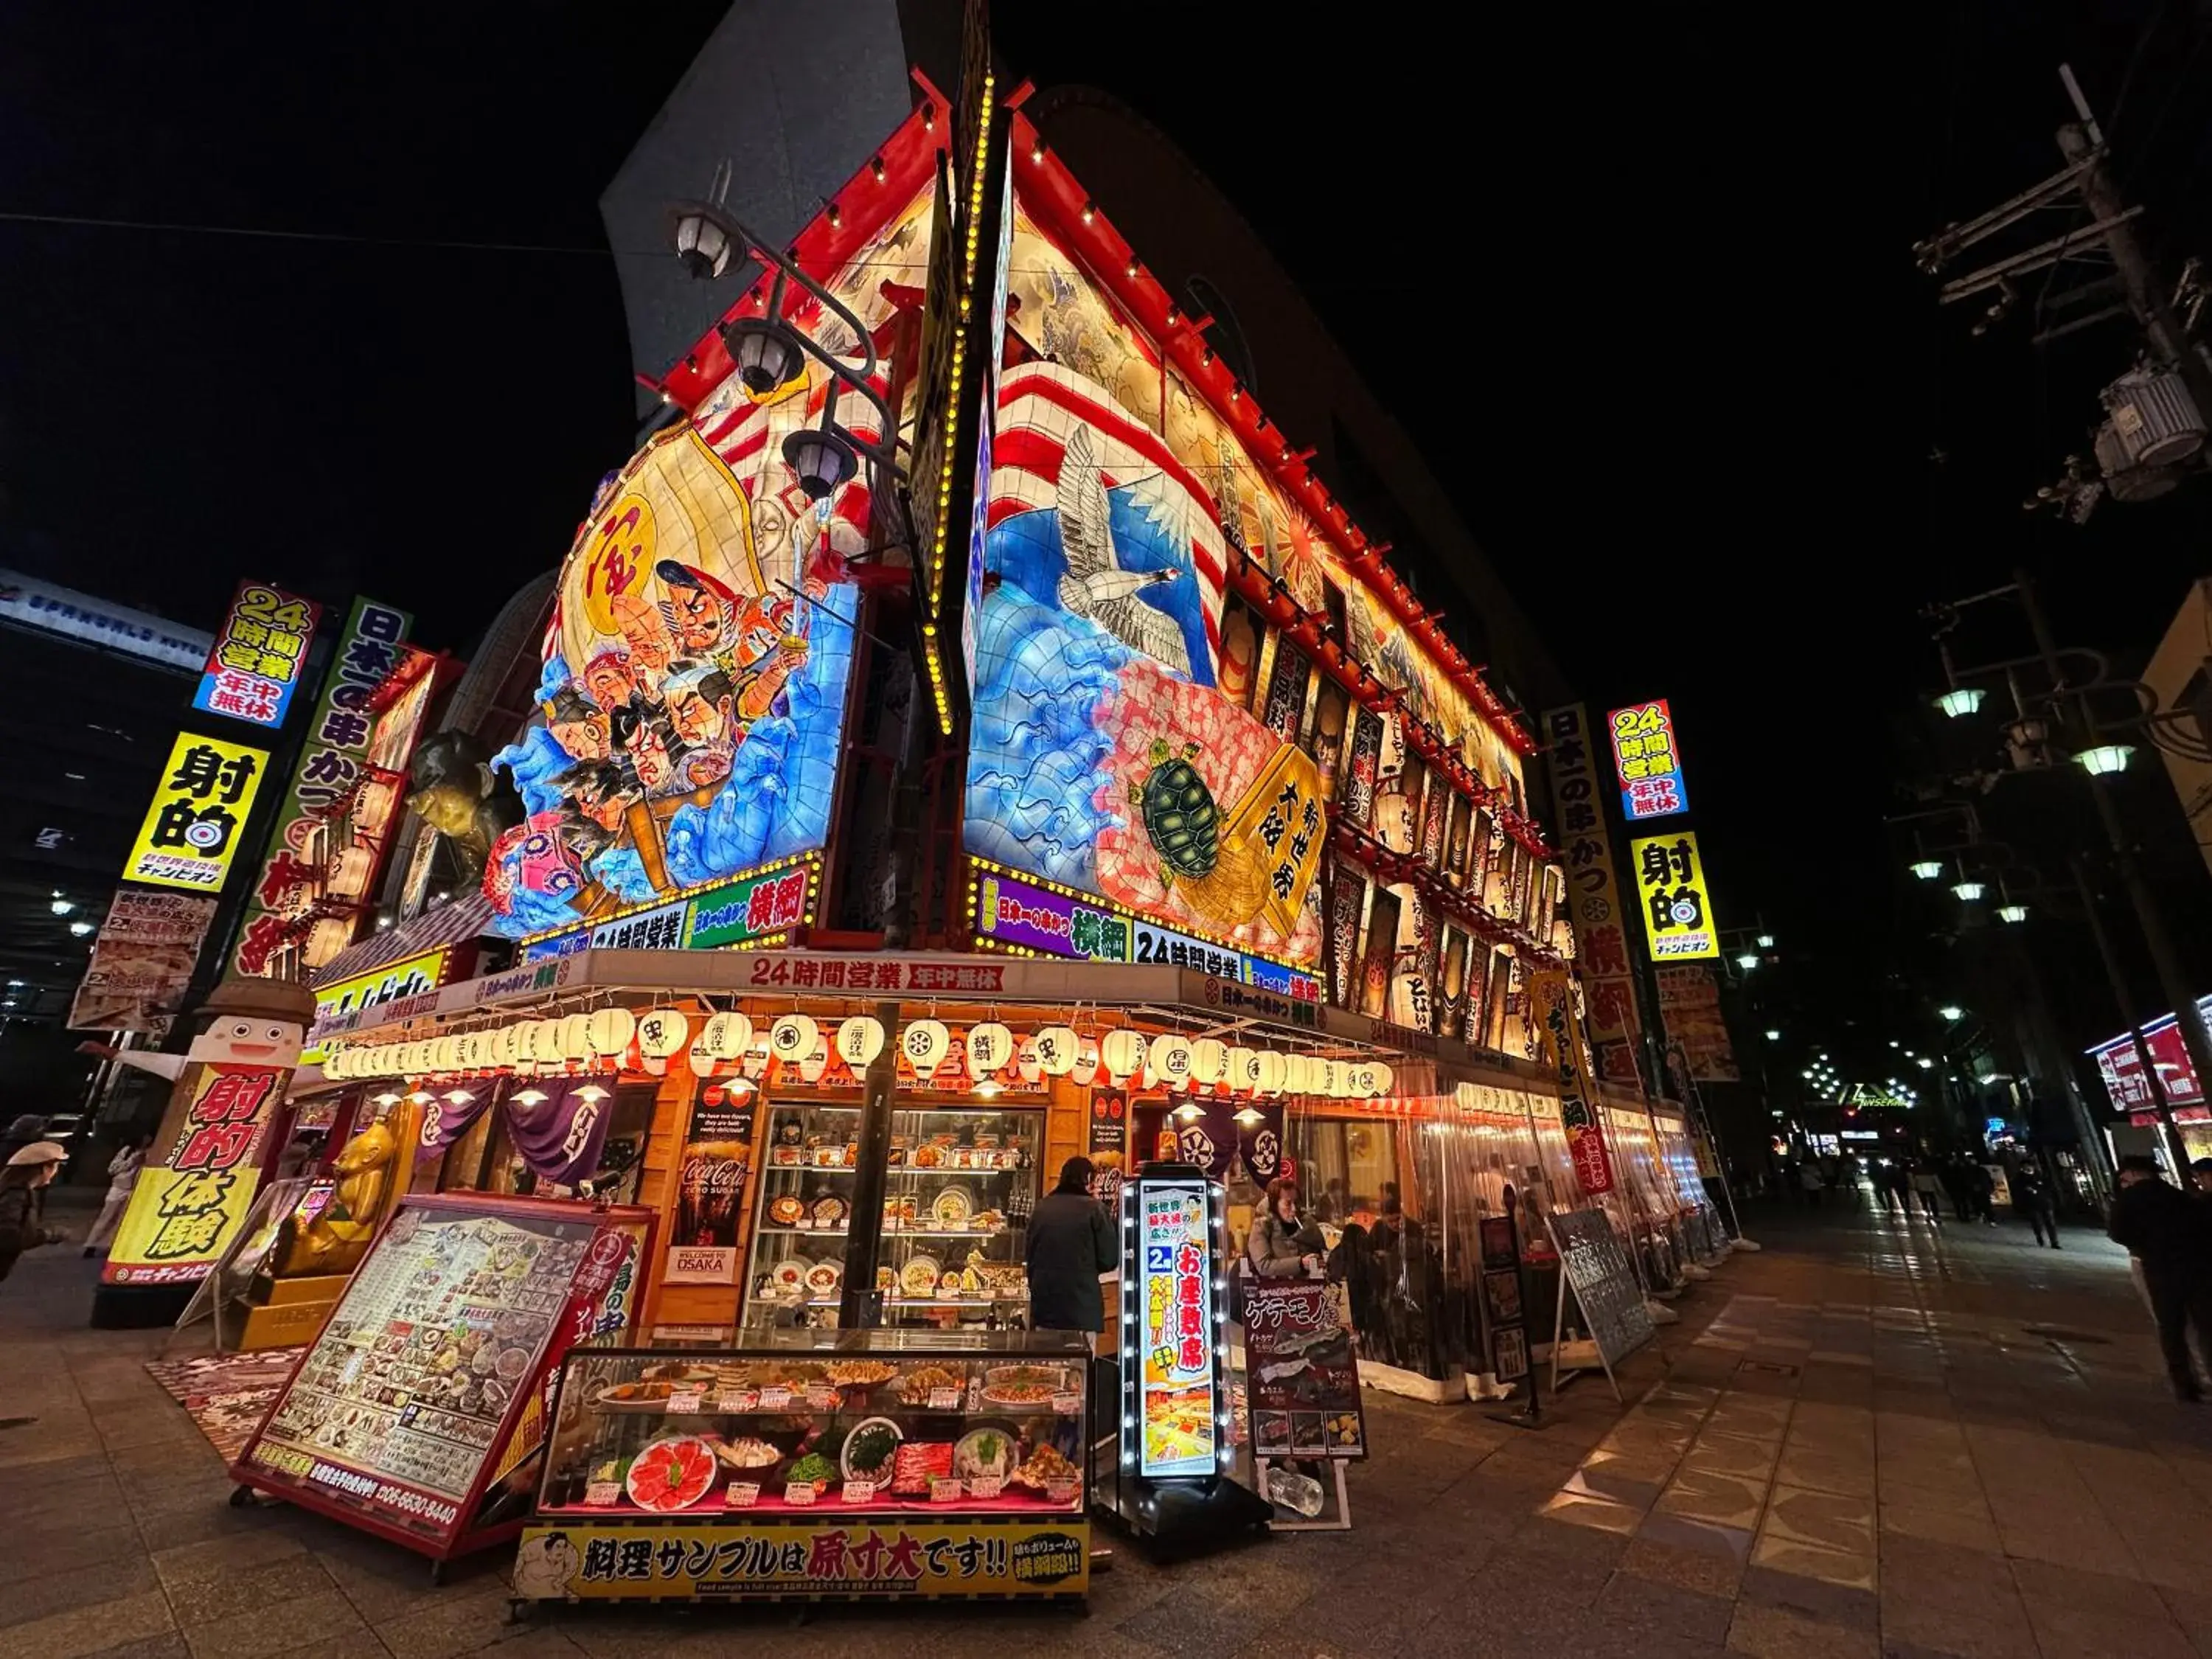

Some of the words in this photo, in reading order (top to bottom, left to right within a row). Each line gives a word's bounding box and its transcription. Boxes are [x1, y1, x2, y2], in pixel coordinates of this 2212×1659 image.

[237, 588, 313, 633] 24
[230, 617, 305, 658] 時間
[219, 643, 297, 684] 営業
[215, 672, 282, 701] 年中
[208, 692, 277, 721] 無休
[1615, 706, 1666, 737] 24
[1618, 732, 1669, 759] 時間
[1621, 754, 1674, 782] 営業
[151, 745, 257, 858] 射的
[1551, 711, 1609, 892] 日本一の串かつ
[1630, 778, 1676, 798] 年中
[1633, 795, 1680, 813] 無休
[137, 863, 218, 883] チャンピオン
[1643, 838, 1704, 932] 射的
[745, 870, 805, 933] 横綱
[998, 897, 1070, 937] 日本一の串かつ
[1071, 907, 1127, 961] 横綱
[1136, 931, 1239, 979] 24時間営業
[1656, 941, 1711, 956] チャンピオン
[751, 958, 902, 989] 24時間営業
[914, 967, 998, 990] 年中無休
[144, 1073, 276, 1259] 射的体験
[1148, 1200, 1180, 1213] 新世界
[677, 1259, 723, 1271] OSAKA
[1177, 1243, 1205, 1369] お座敷席
[582, 1528, 1007, 1582] 料理サンプルは原寸大です!!
